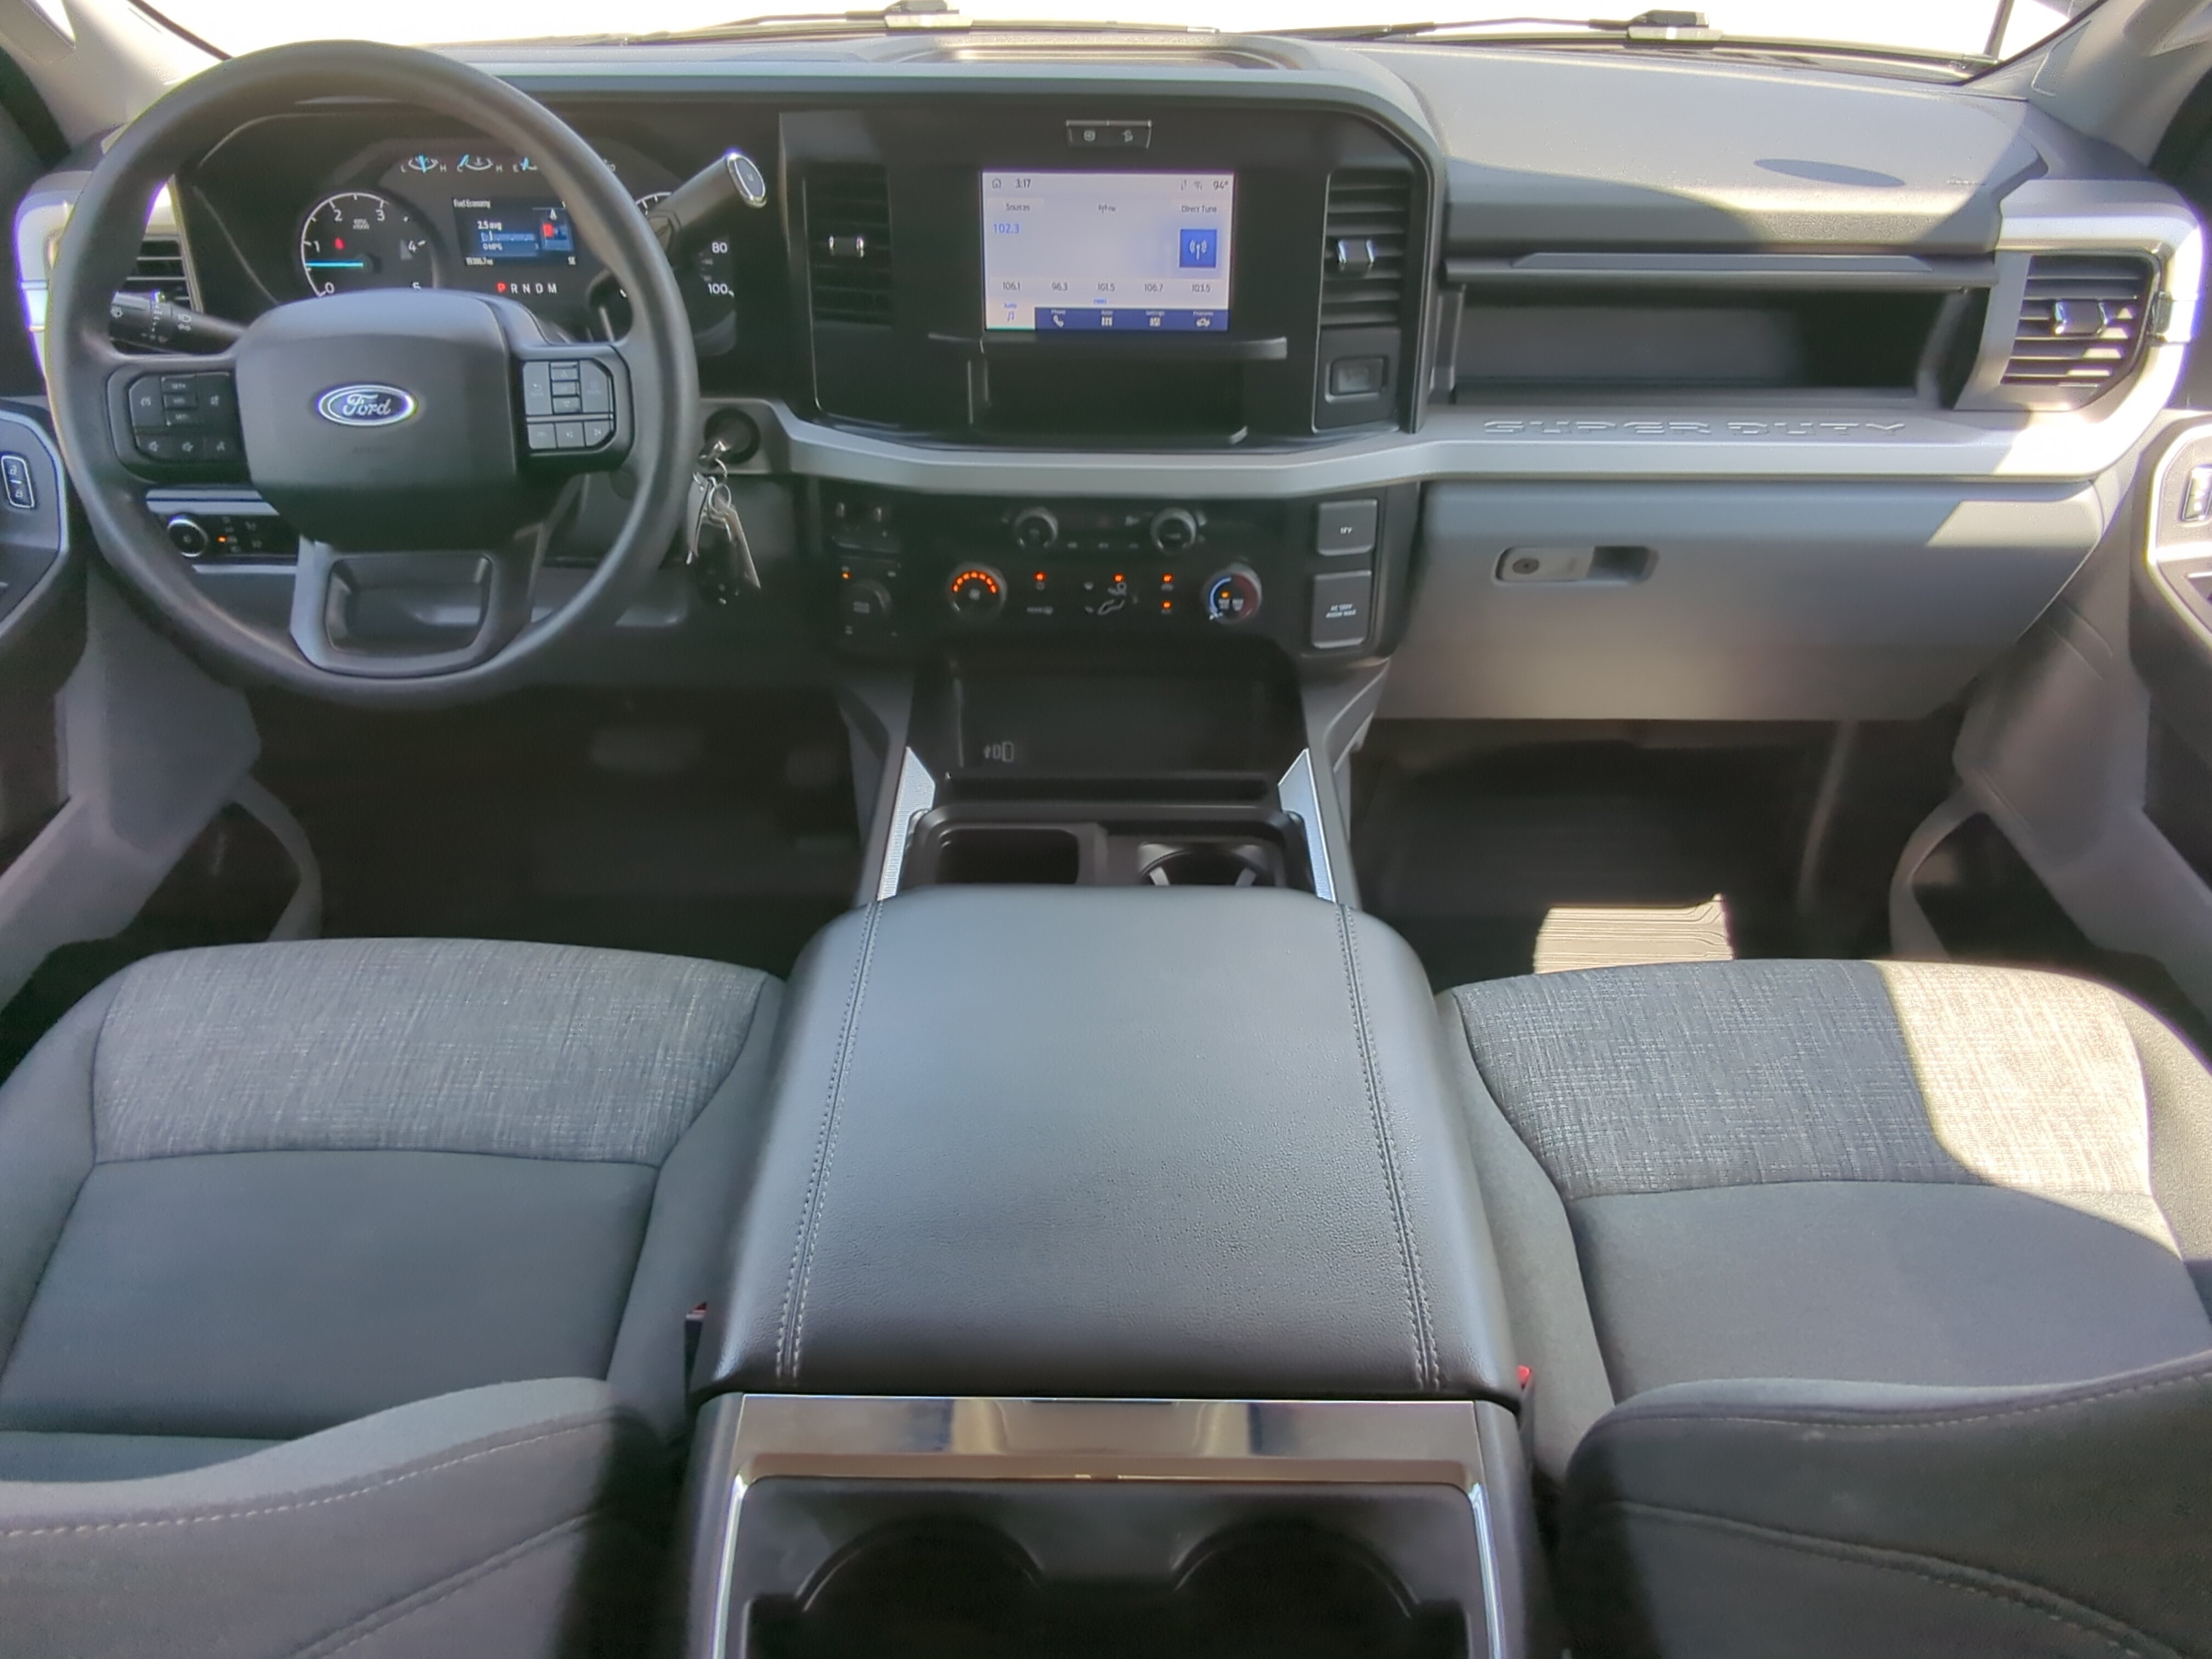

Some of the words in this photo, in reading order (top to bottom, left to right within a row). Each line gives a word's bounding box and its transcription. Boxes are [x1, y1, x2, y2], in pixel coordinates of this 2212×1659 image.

[1015, 179, 1031, 189] 3:17
[1201, 205, 1217, 213] Tune
[334, 210, 343, 221] 2
[376, 210, 385, 221] 3
[993, 223, 1020, 234] 102.3
[313, 240, 320, 253] 1
[408, 240, 417, 252] 4
[712, 242, 727, 253] 80
[325, 283, 334, 294] 0
[498, 284, 506, 293] P
[511, 284, 518, 293] R
[523, 284, 531, 294] N
[536, 284, 543, 294] D
[548, 284, 557, 294] M
[708, 284, 727, 294] 100
[342, 393, 392, 416] Ford
[1483, 420, 1712, 435] SUPER
[1726, 422, 1906, 436] DUTY
